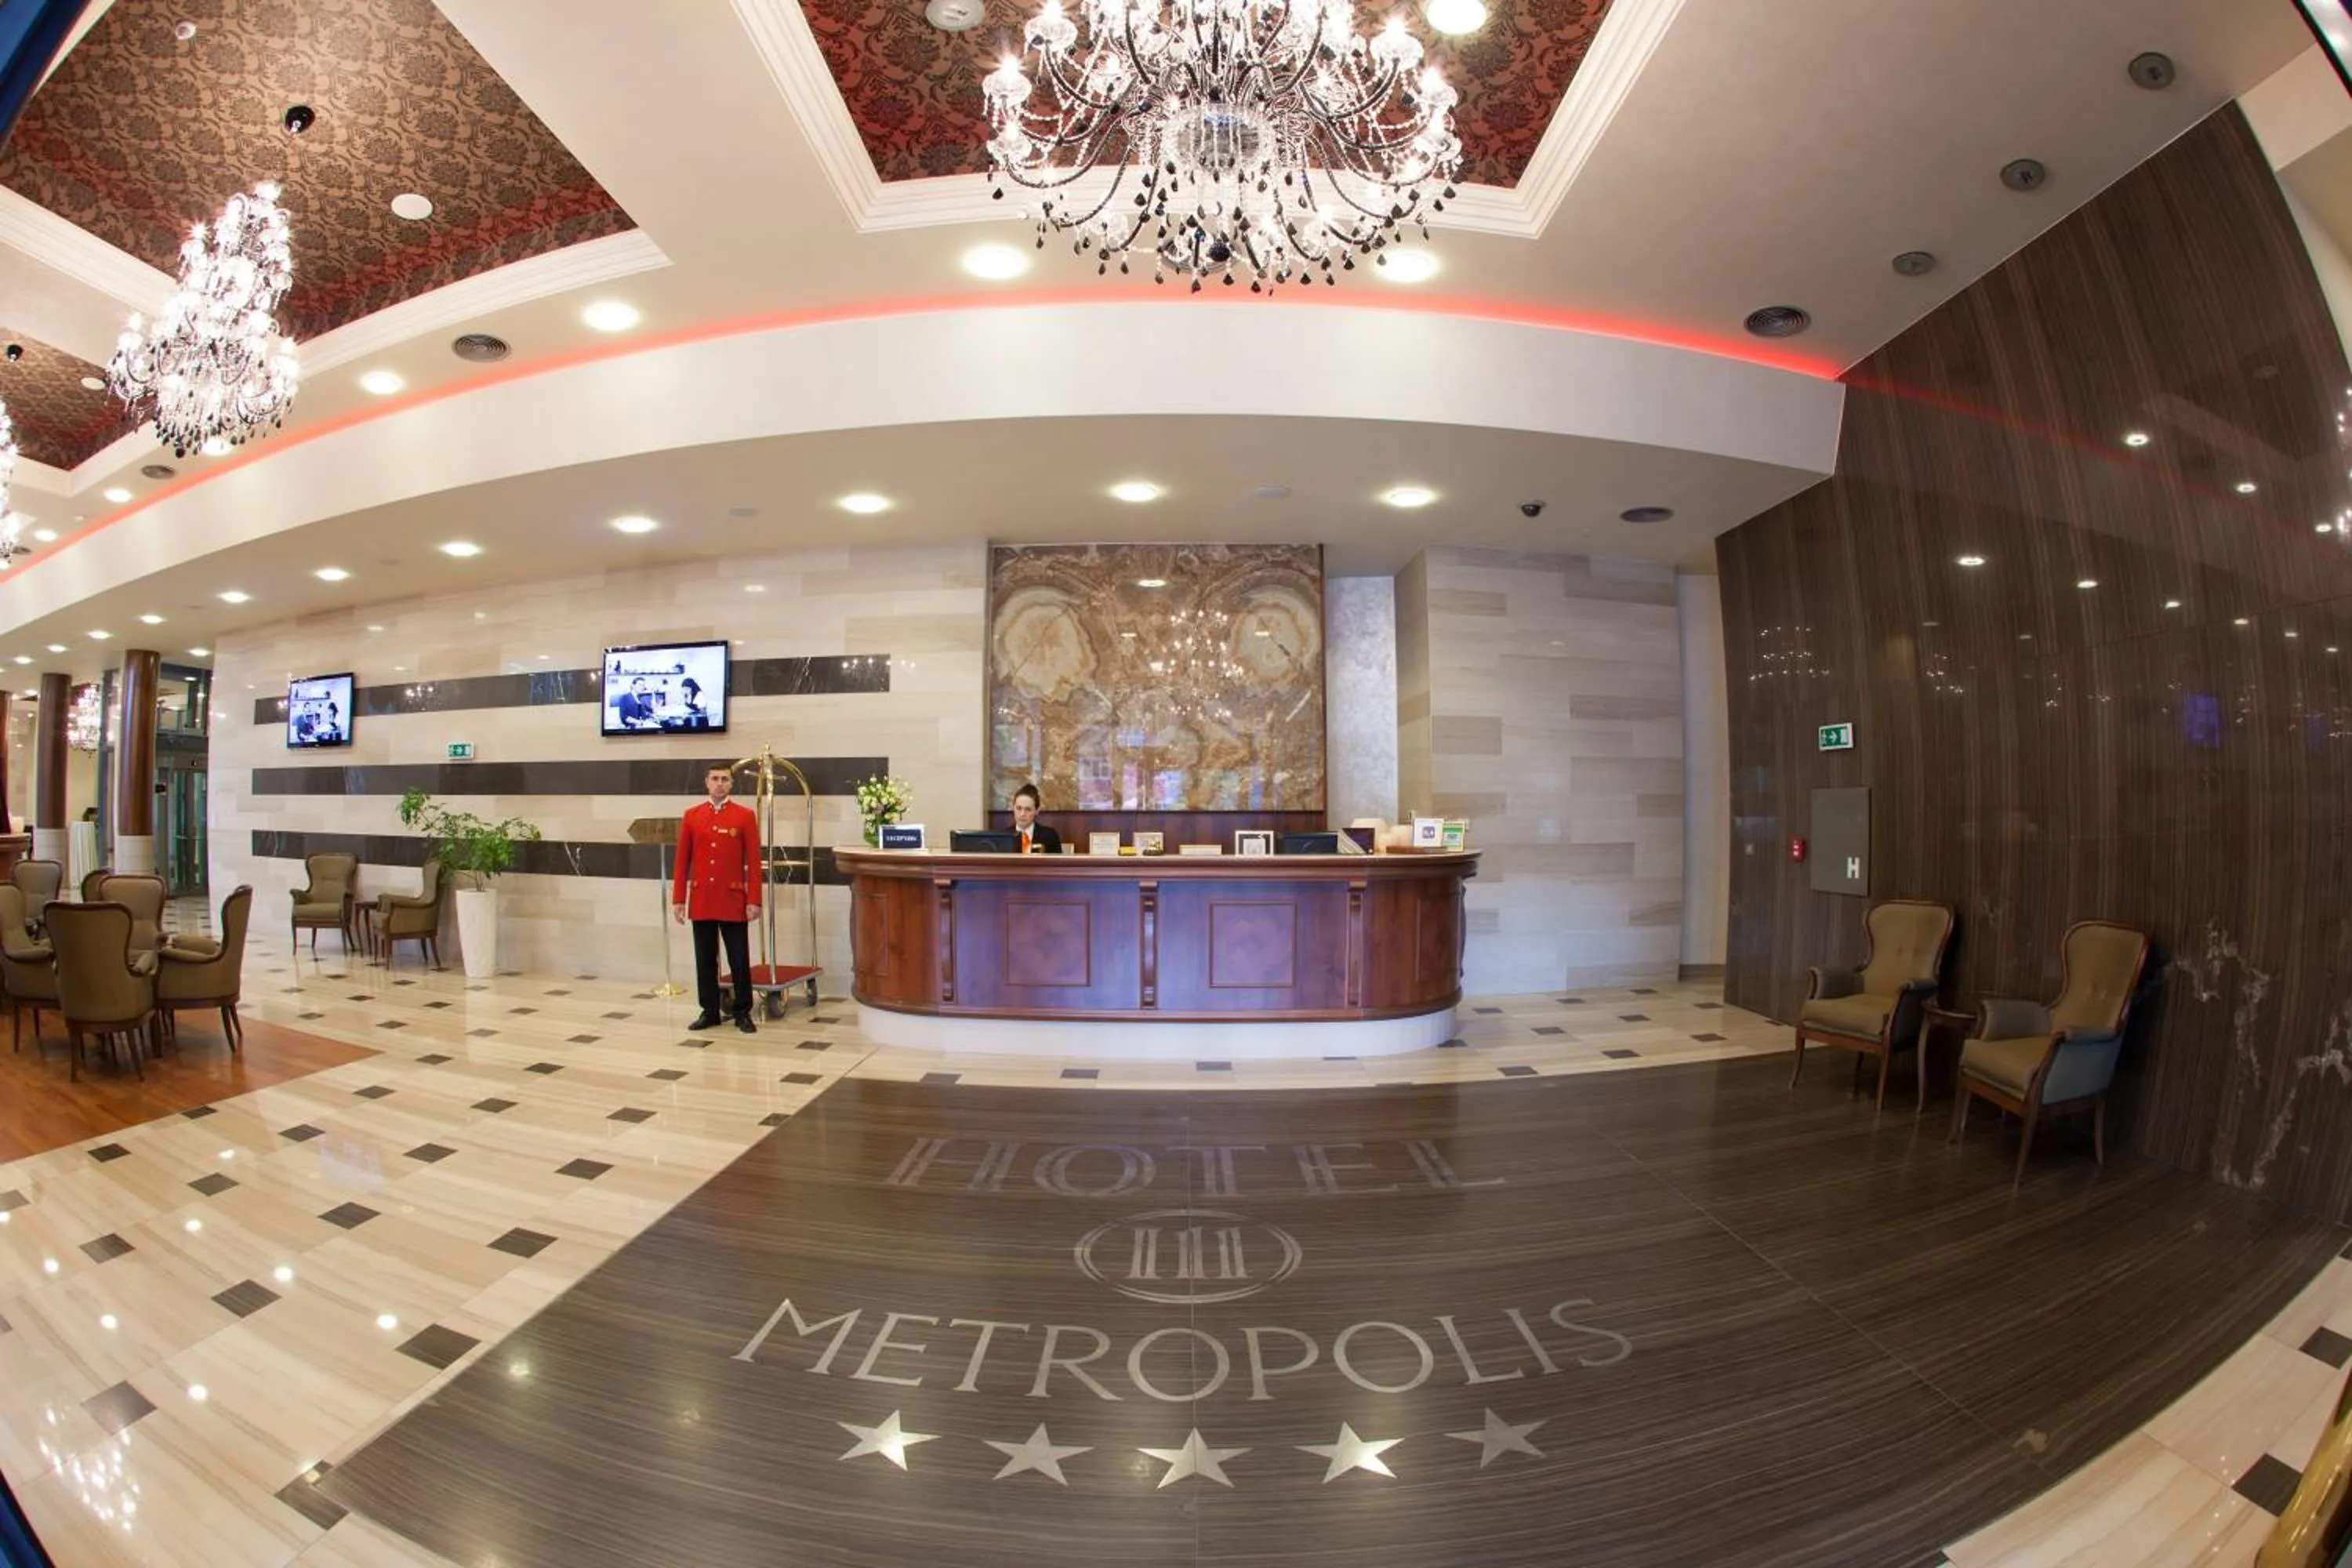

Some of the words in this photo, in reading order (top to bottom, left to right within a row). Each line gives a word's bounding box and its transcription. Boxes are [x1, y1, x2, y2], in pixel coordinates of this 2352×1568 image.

[1847, 857, 1860, 879] H
[886, 1138, 1505, 1196] HOTEL
[731, 1298, 1633, 1402] METROPOLIS
